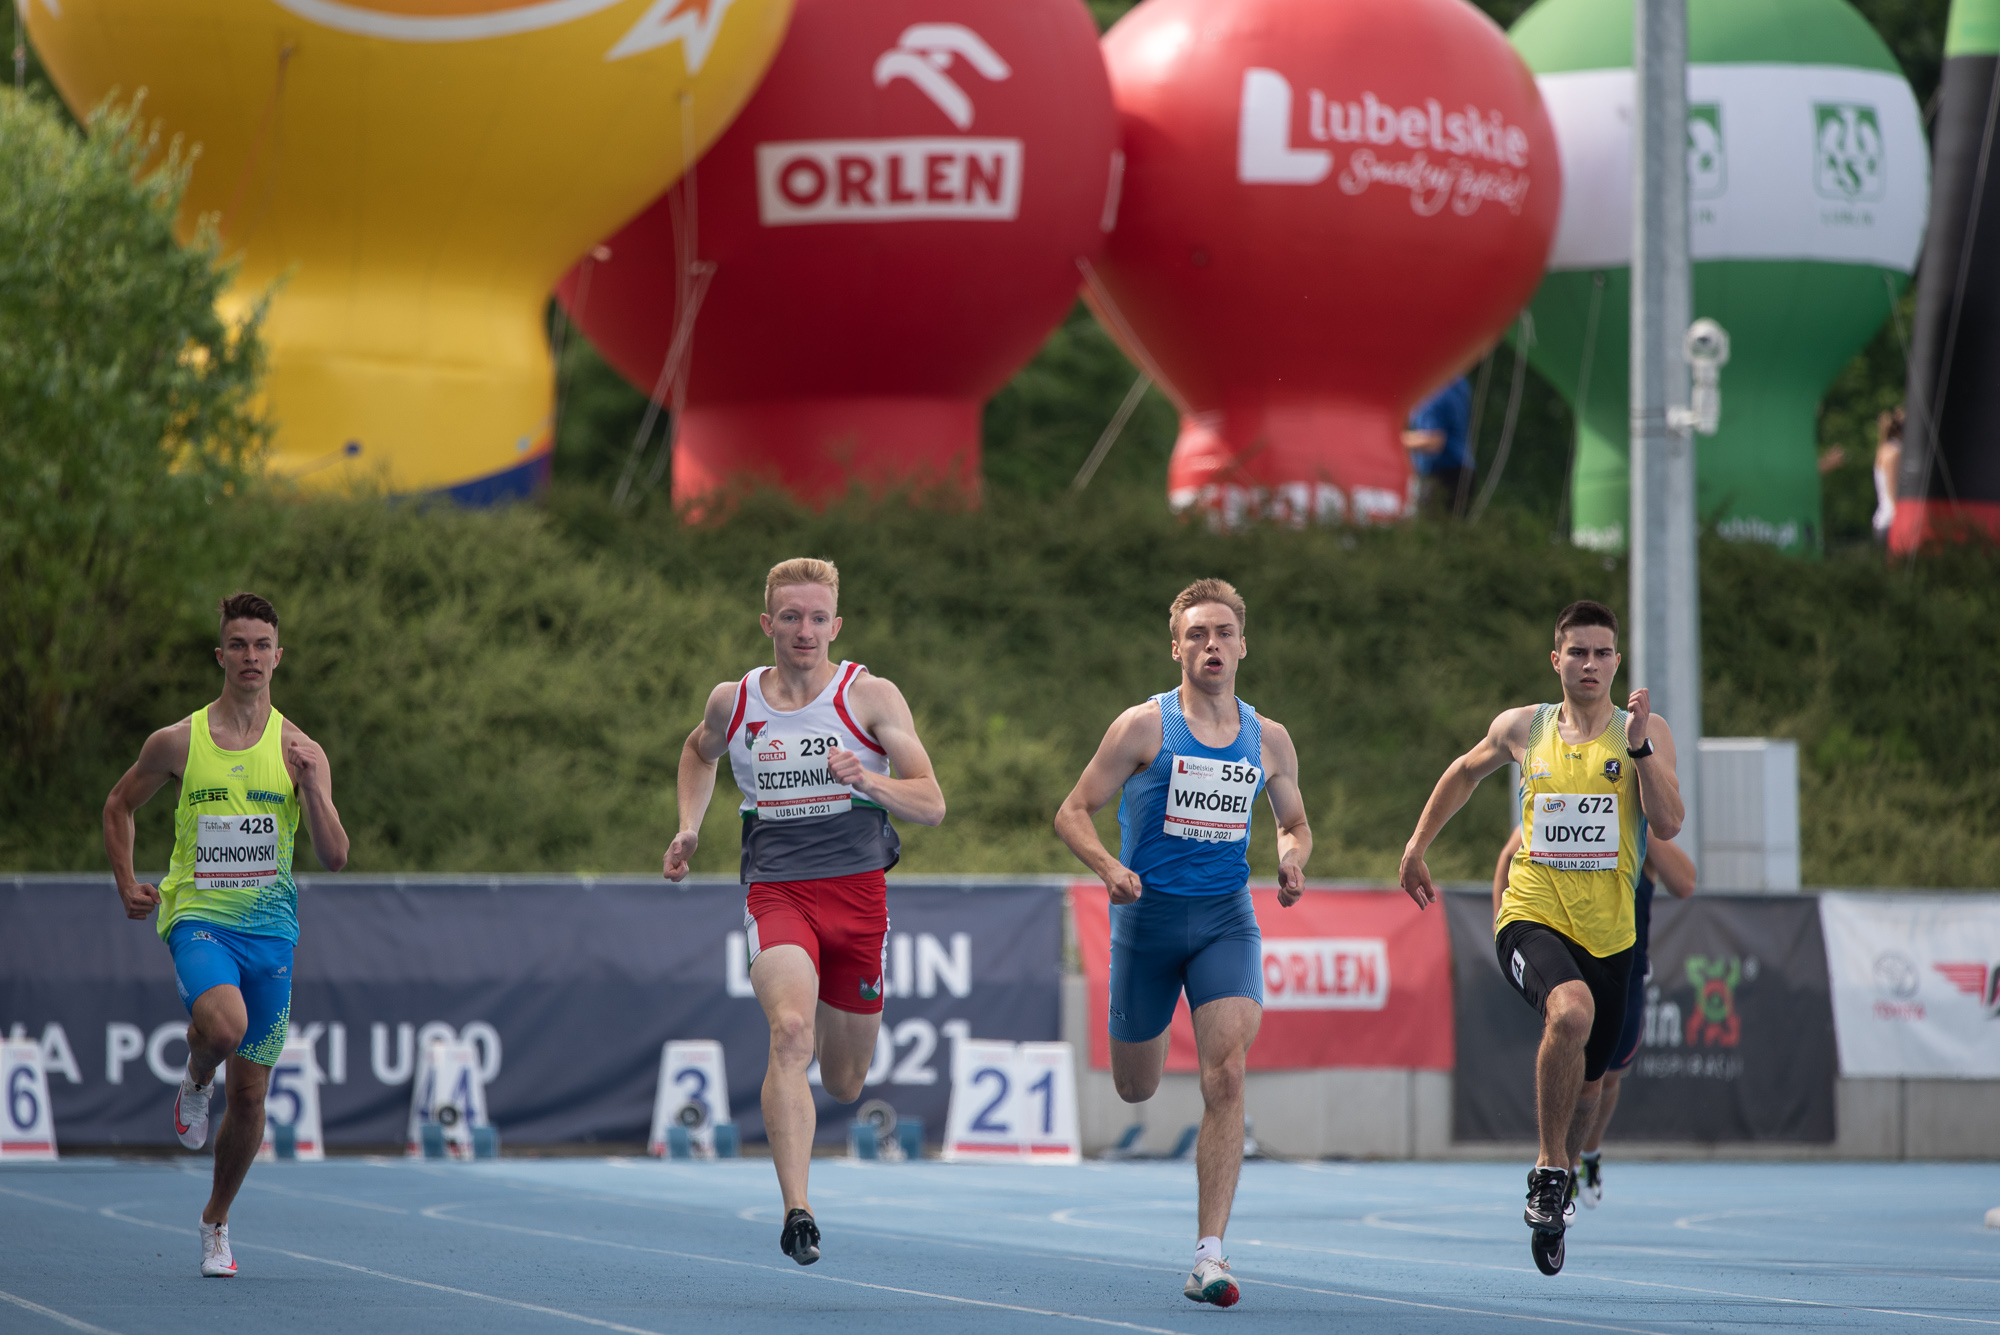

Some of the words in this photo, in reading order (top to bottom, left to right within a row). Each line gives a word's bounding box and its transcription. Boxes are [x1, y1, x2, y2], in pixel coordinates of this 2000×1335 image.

[778, 150, 1004, 208] ORLEN
[759, 753, 785, 761] ORLEN
[758, 768, 839, 790] SZCZEPANIA
[1221, 764, 1256, 784] 556
[776, 807, 806, 817] LUBLIN
[809, 805, 831, 814] 2021
[1174, 789, 1247, 813] WRÓBEL
[1578, 797, 1613, 813] 672
[240, 817, 274, 834] 428
[1182, 827, 1212, 838] LUBLIN
[1213, 831, 1232, 839] 2021
[1545, 826, 1606, 842] UDYCZ
[196, 844, 275, 863] DUCHNOWSKI
[1548, 860, 1577, 868] LUBLIN
[1580, 860, 1600, 868] 2021
[210, 880, 239, 888] LUBLIN
[241, 879, 260, 887] 2021
[725, 932, 972, 998] LIN
[1263, 953, 1377, 995] ORLEN
[106, 1020, 346, 1085] POKI
[7, 1066, 38, 1130] 6
[268, 1068, 301, 1124] 5
[969, 1068, 1010, 1133] 2
[1028, 1070, 1053, 1134] 1
